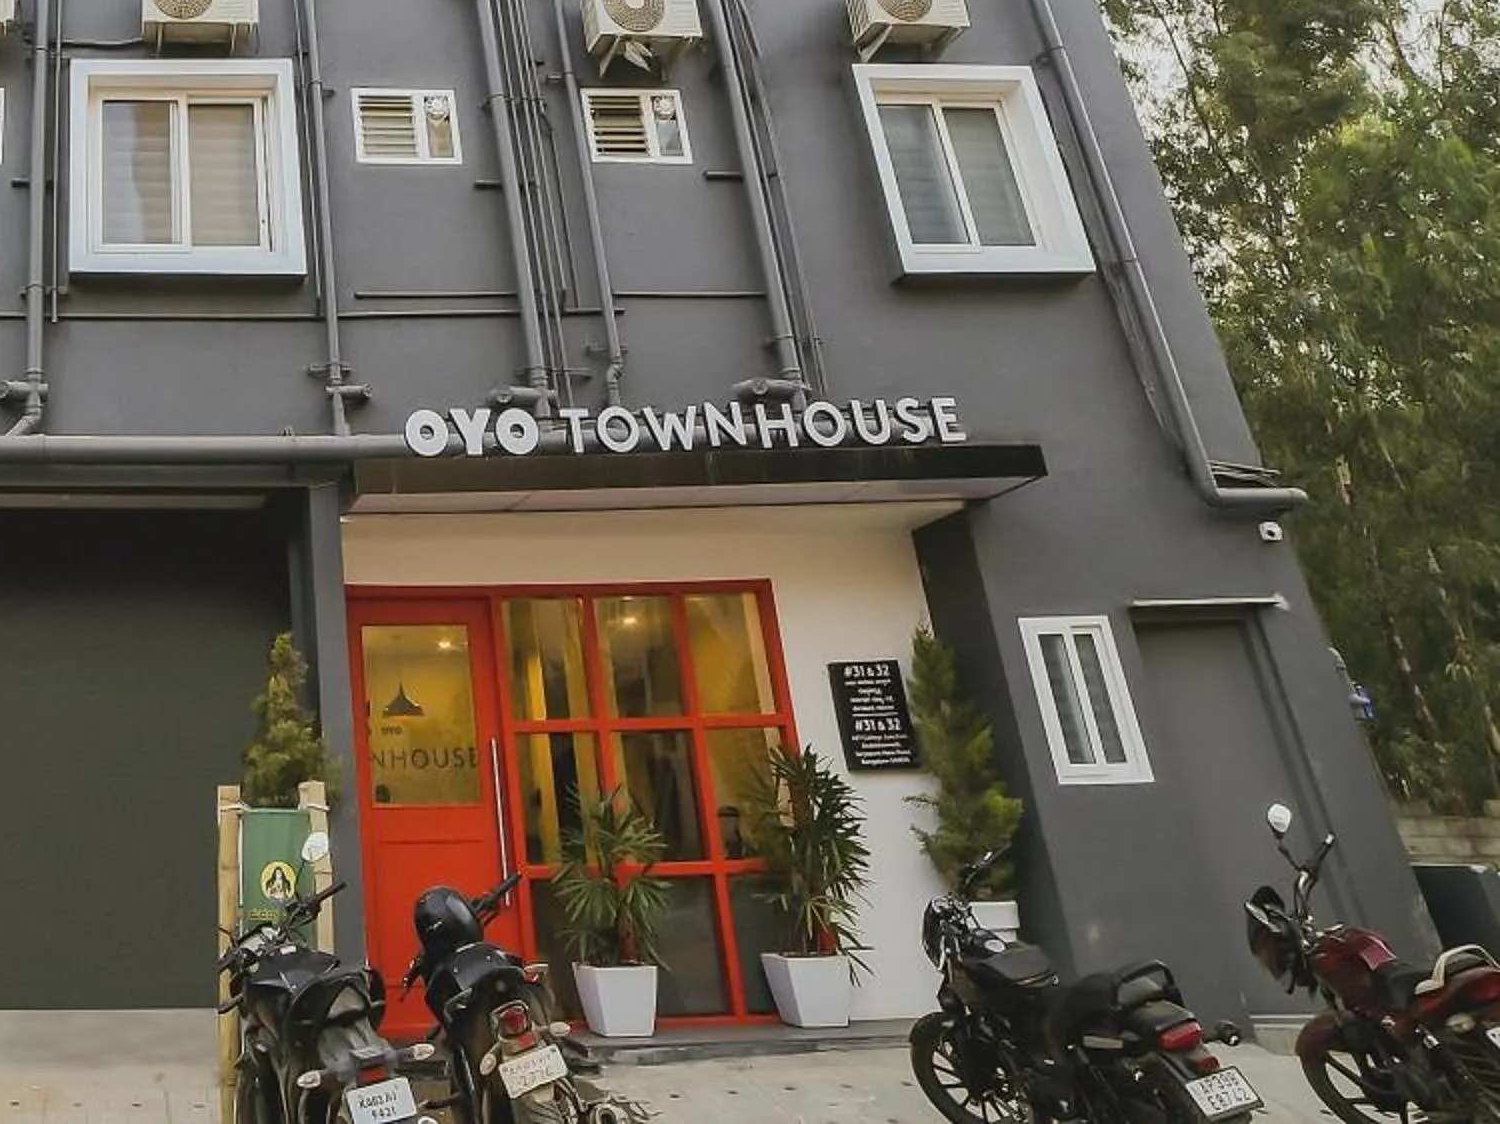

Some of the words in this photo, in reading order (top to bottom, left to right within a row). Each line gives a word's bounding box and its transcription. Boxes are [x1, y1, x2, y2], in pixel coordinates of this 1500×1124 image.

[404, 408, 539, 458] OYO
[559, 396, 968, 454] TOWNHOUSE
[876, 664, 890, 677] 32
[886, 718, 901, 731] 32
